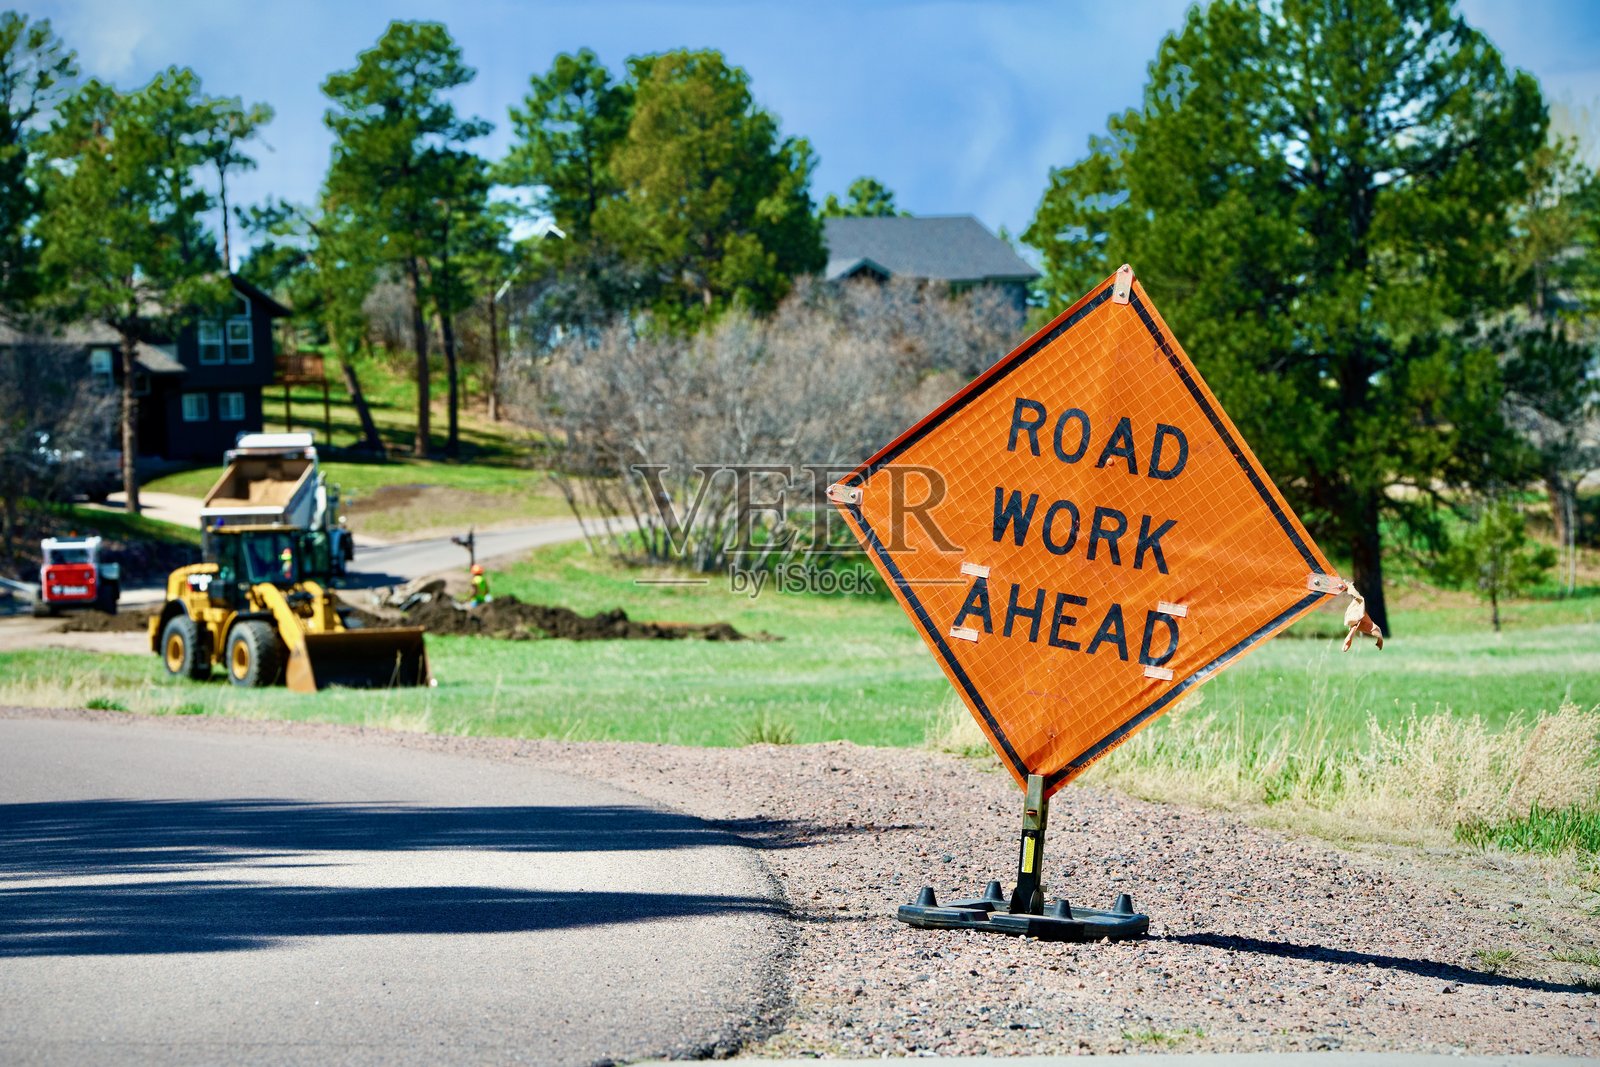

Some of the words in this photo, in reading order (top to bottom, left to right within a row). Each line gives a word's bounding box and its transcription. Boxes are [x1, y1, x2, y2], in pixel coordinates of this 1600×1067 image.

[1007, 397, 1189, 480] ROAD
[992, 486, 1178, 575] WORK
[952, 577, 1180, 666] AHEAD
[1074, 761, 1091, 774] ROAD
[1091, 748, 1110, 761] WORK
[1110, 732, 1131, 749] AHEAD
